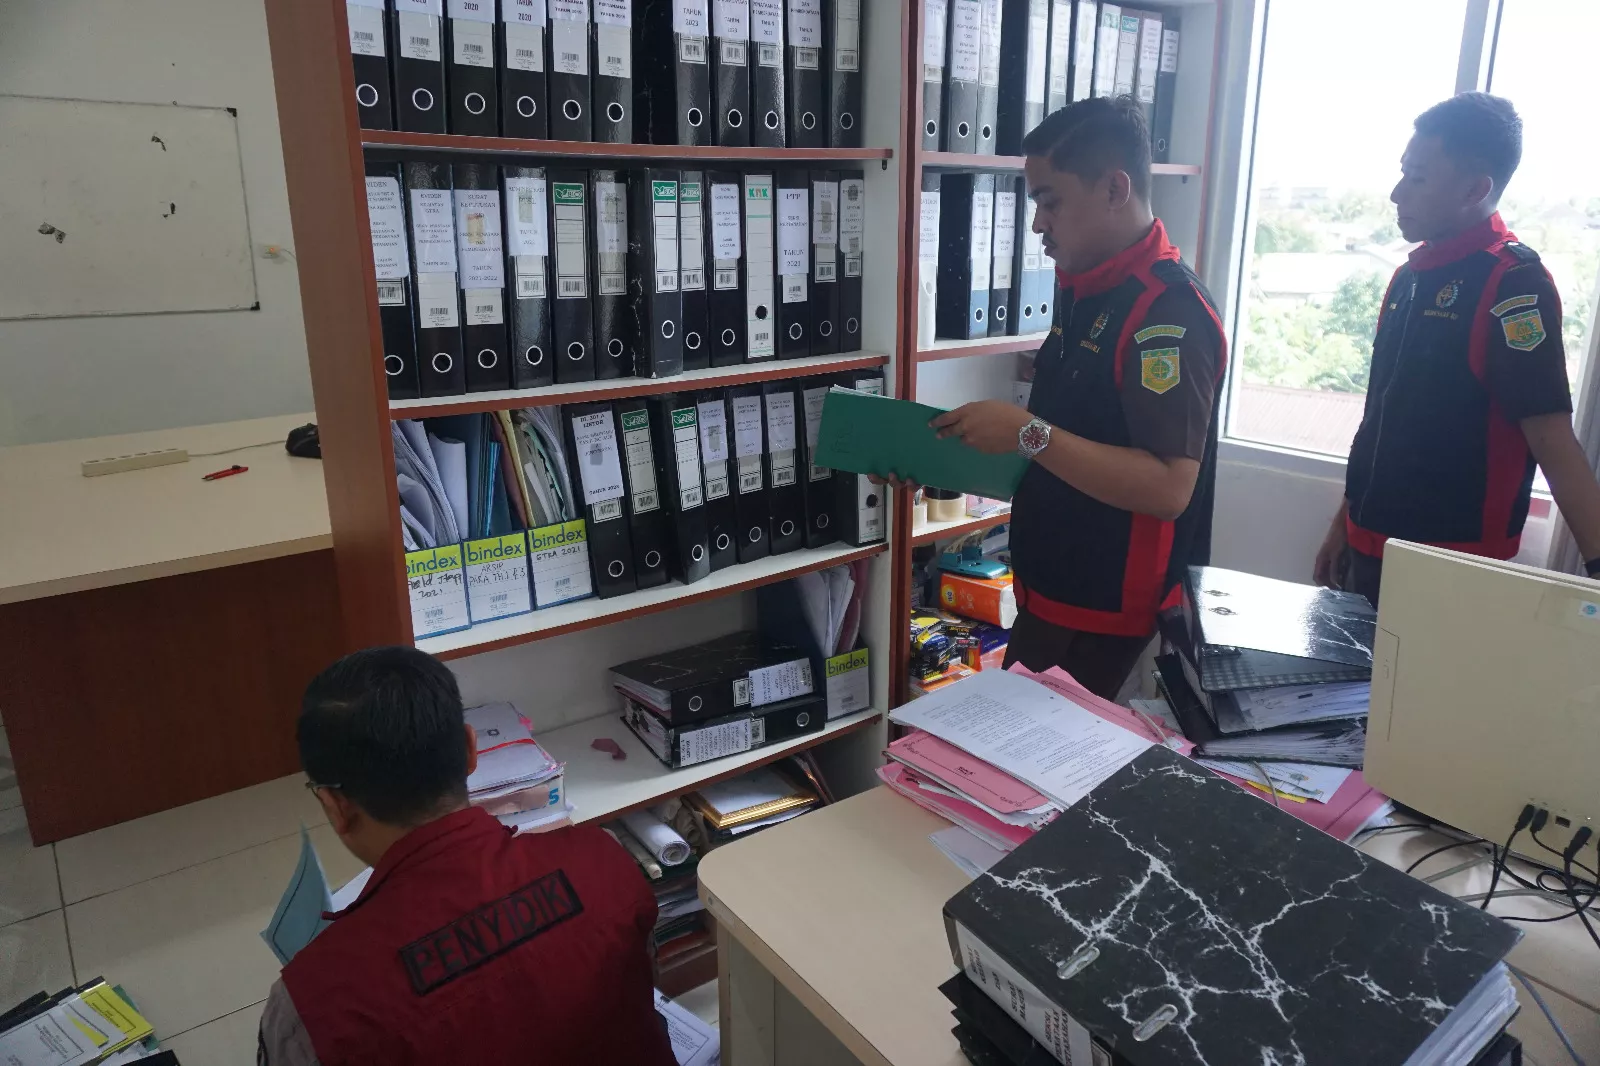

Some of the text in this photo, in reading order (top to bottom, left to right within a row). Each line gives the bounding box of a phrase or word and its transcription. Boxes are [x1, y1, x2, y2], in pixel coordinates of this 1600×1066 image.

[464, 2, 479, 11] 2020
[683, 7, 702, 16] TAHUN
[518, 13, 532, 22] 2020
[686, 19, 698, 27] 2023
[531, 525, 583, 549] bindex
[467, 536, 523, 562] bindex
[828, 653, 866, 674] bindex
[549, 788, 559, 805] 5
[409, 878, 571, 986] PENYIDIK
